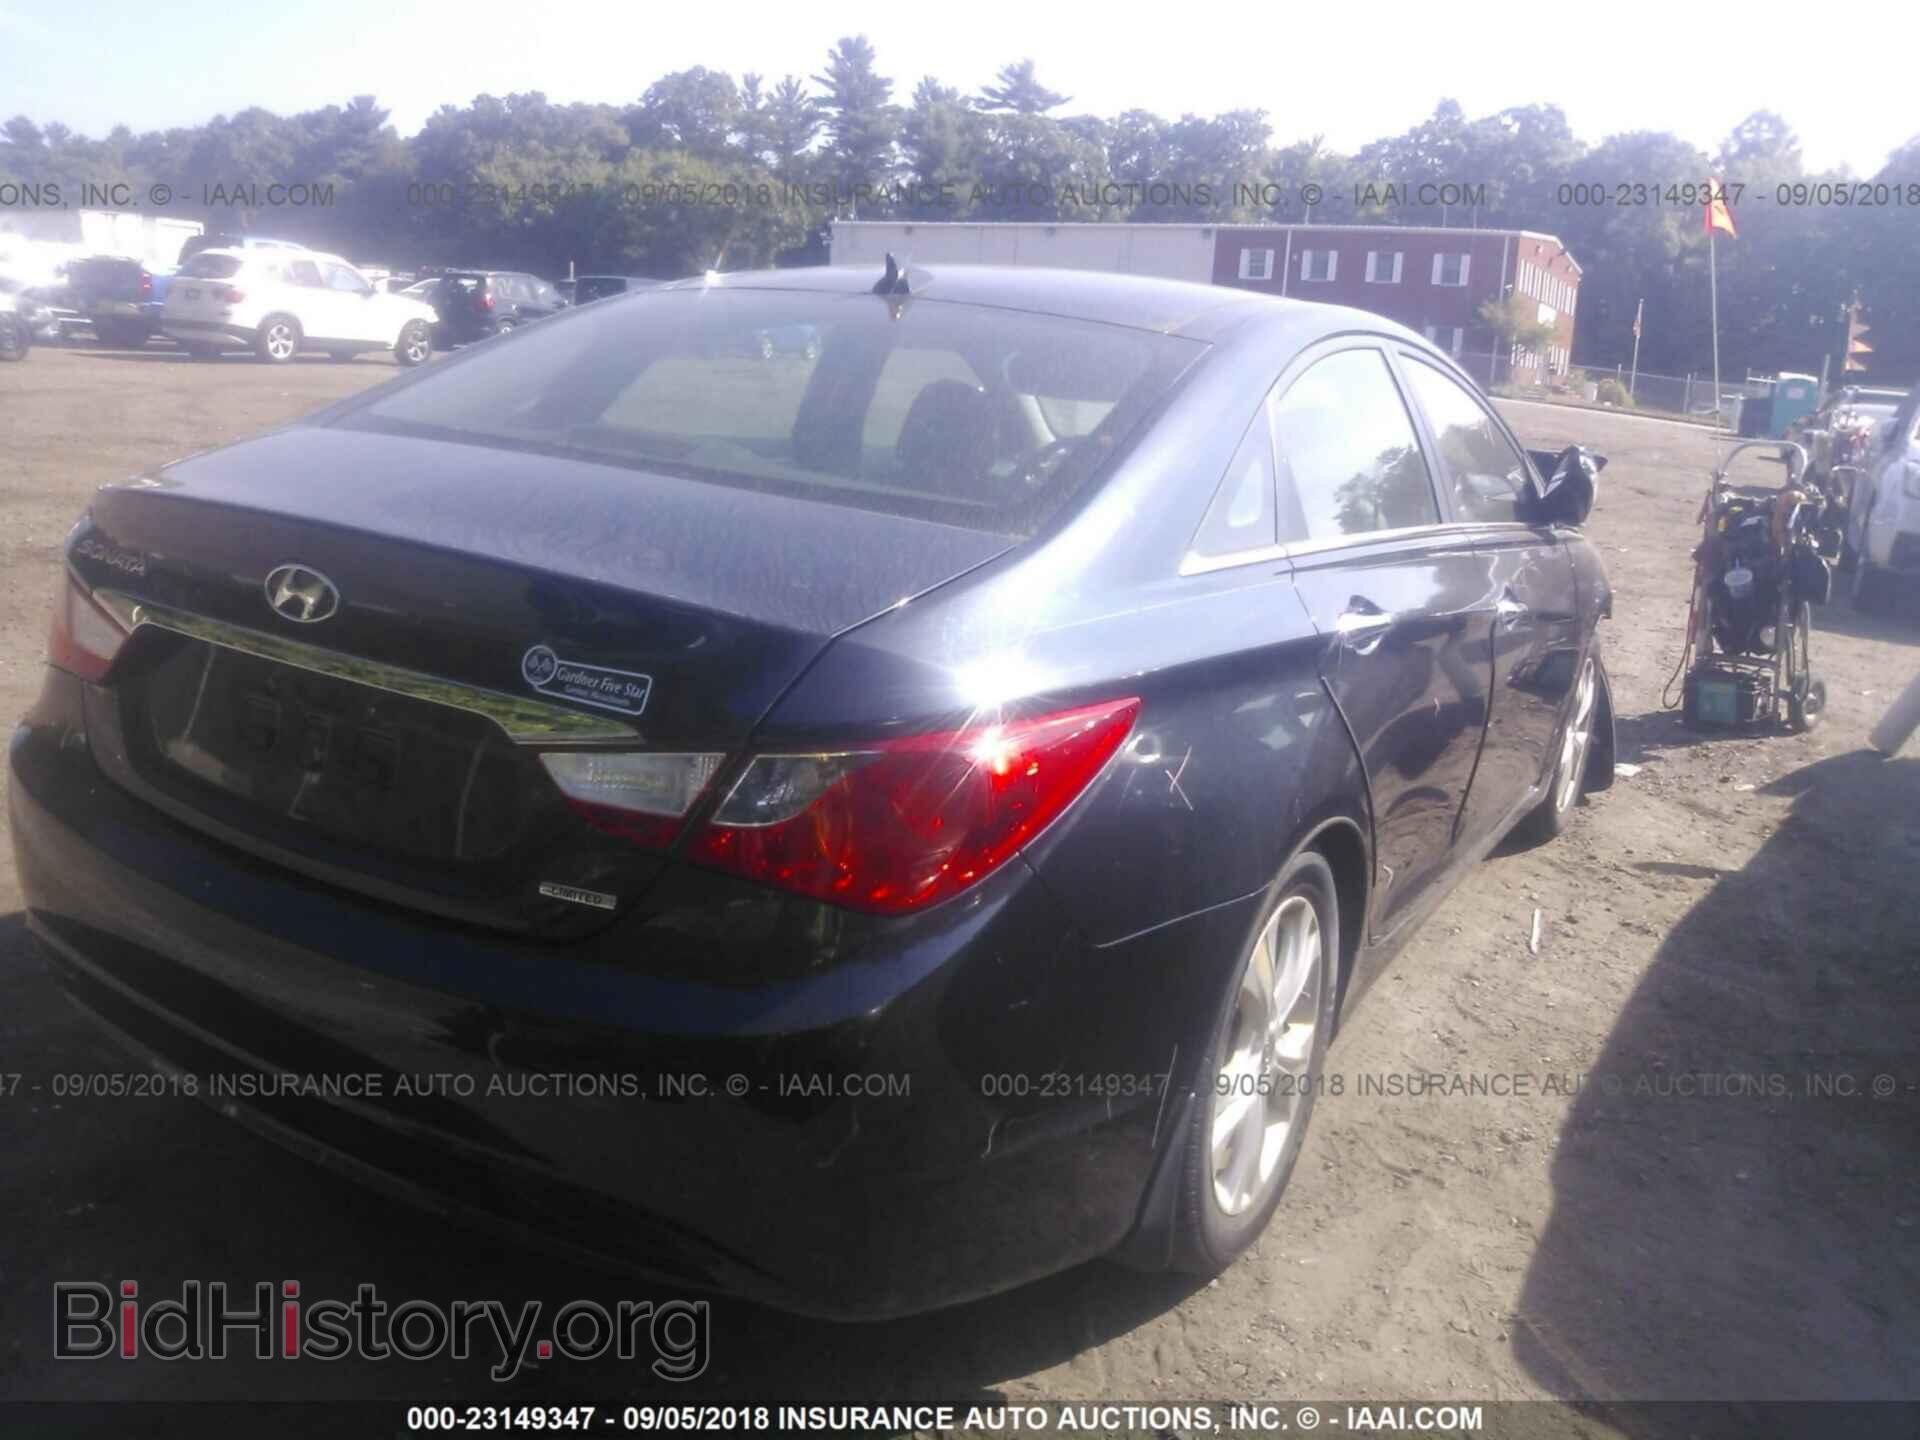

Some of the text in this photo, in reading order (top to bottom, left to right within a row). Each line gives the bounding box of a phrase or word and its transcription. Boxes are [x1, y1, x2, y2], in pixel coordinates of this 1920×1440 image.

[556, 667, 599, 688] Gardner
[600, 677, 623, 694] Five
[624, 682, 646, 699] Star
